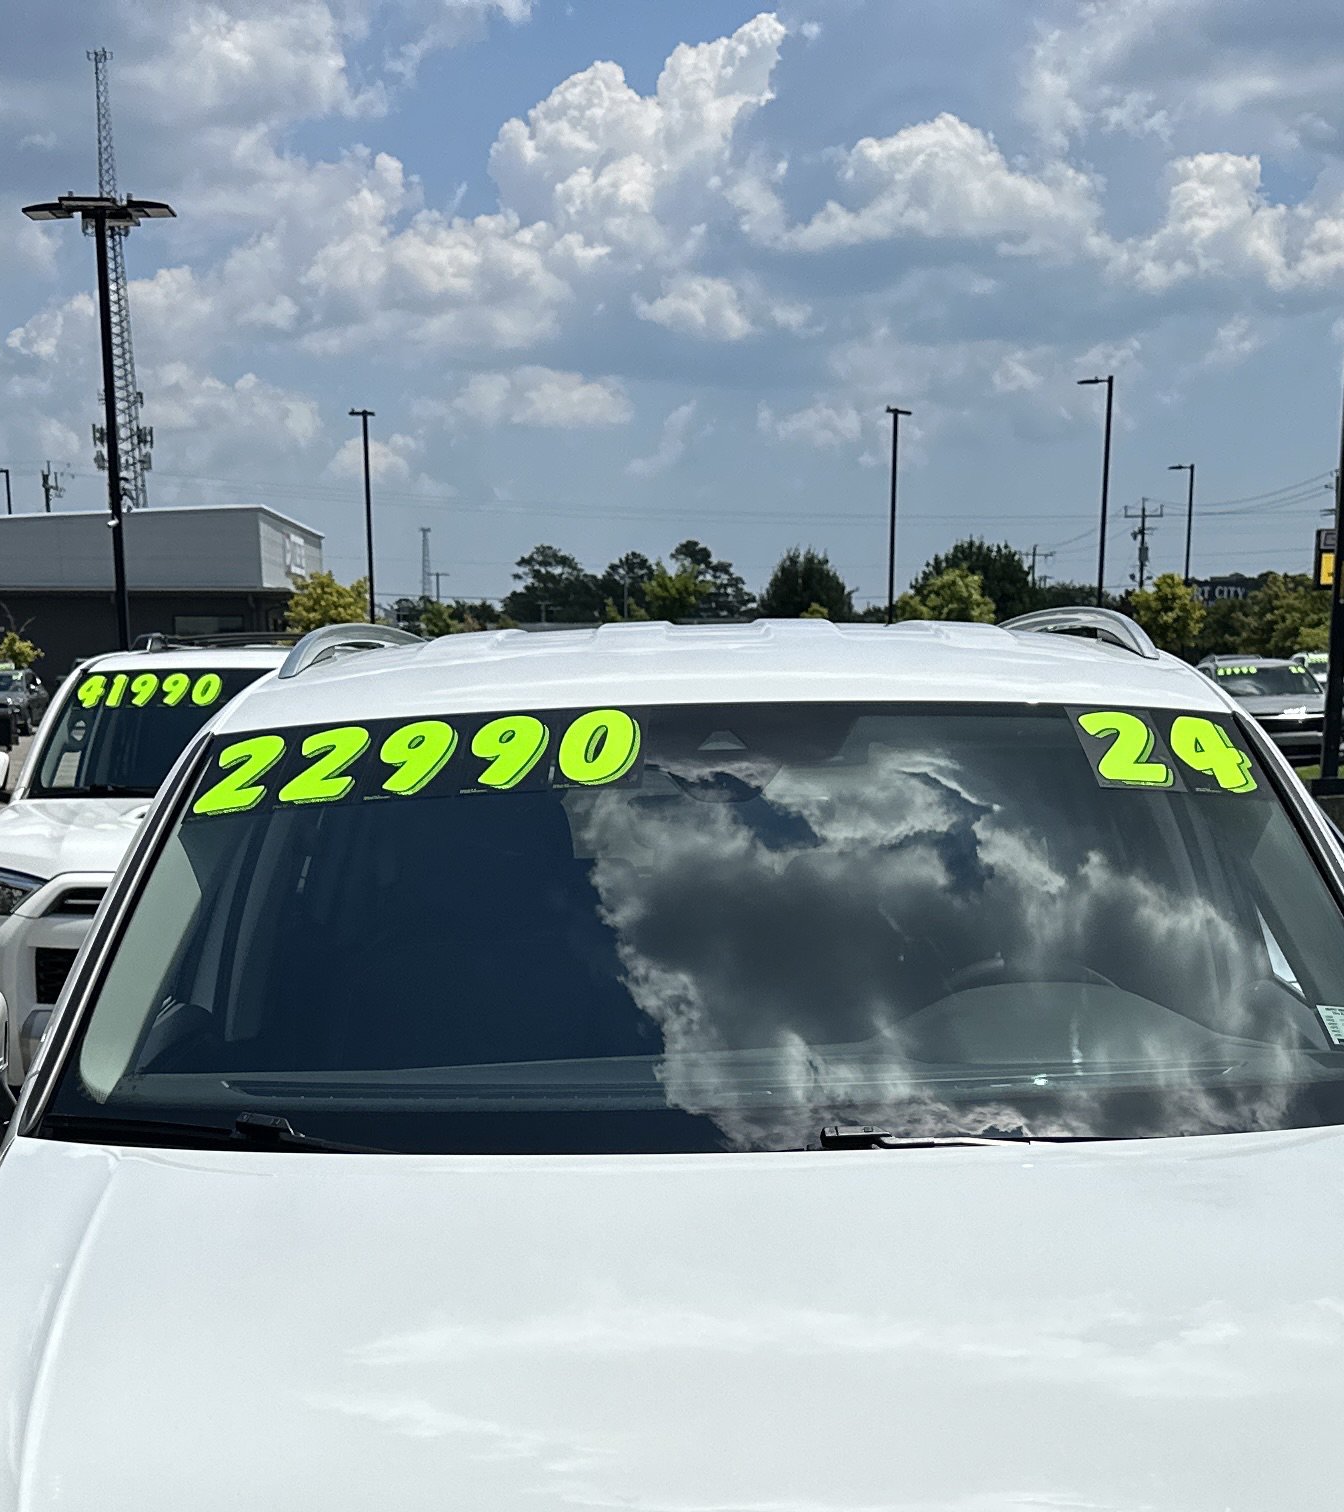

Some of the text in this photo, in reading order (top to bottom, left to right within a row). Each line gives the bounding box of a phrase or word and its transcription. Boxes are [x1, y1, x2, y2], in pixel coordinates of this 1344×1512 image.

[1215, 586, 1245, 599] CITY
[77, 673, 222, 708] 41990
[193, 709, 1257, 816] 22990 24
